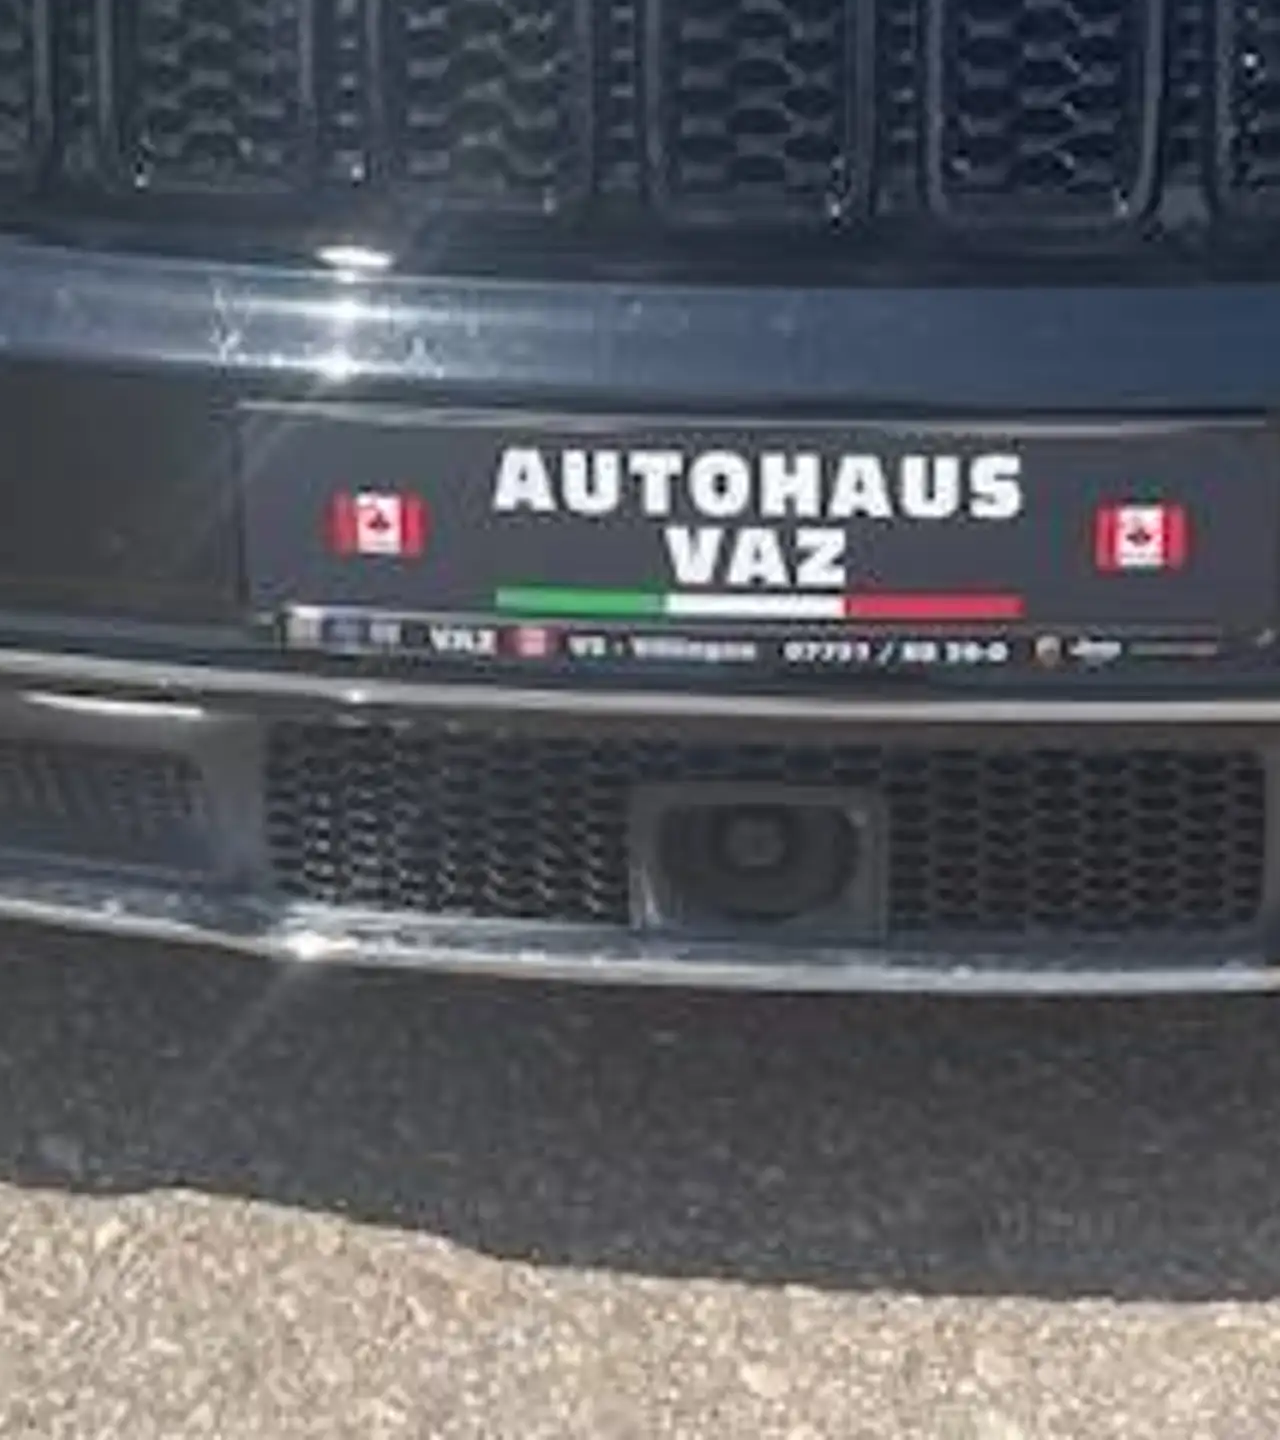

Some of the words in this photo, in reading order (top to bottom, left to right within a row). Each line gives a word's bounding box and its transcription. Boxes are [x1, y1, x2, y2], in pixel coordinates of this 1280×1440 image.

[493, 448, 1022, 519] AUTOHAUS
[665, 527, 847, 587] VAZ
[429, 627, 497, 656] VAZ
